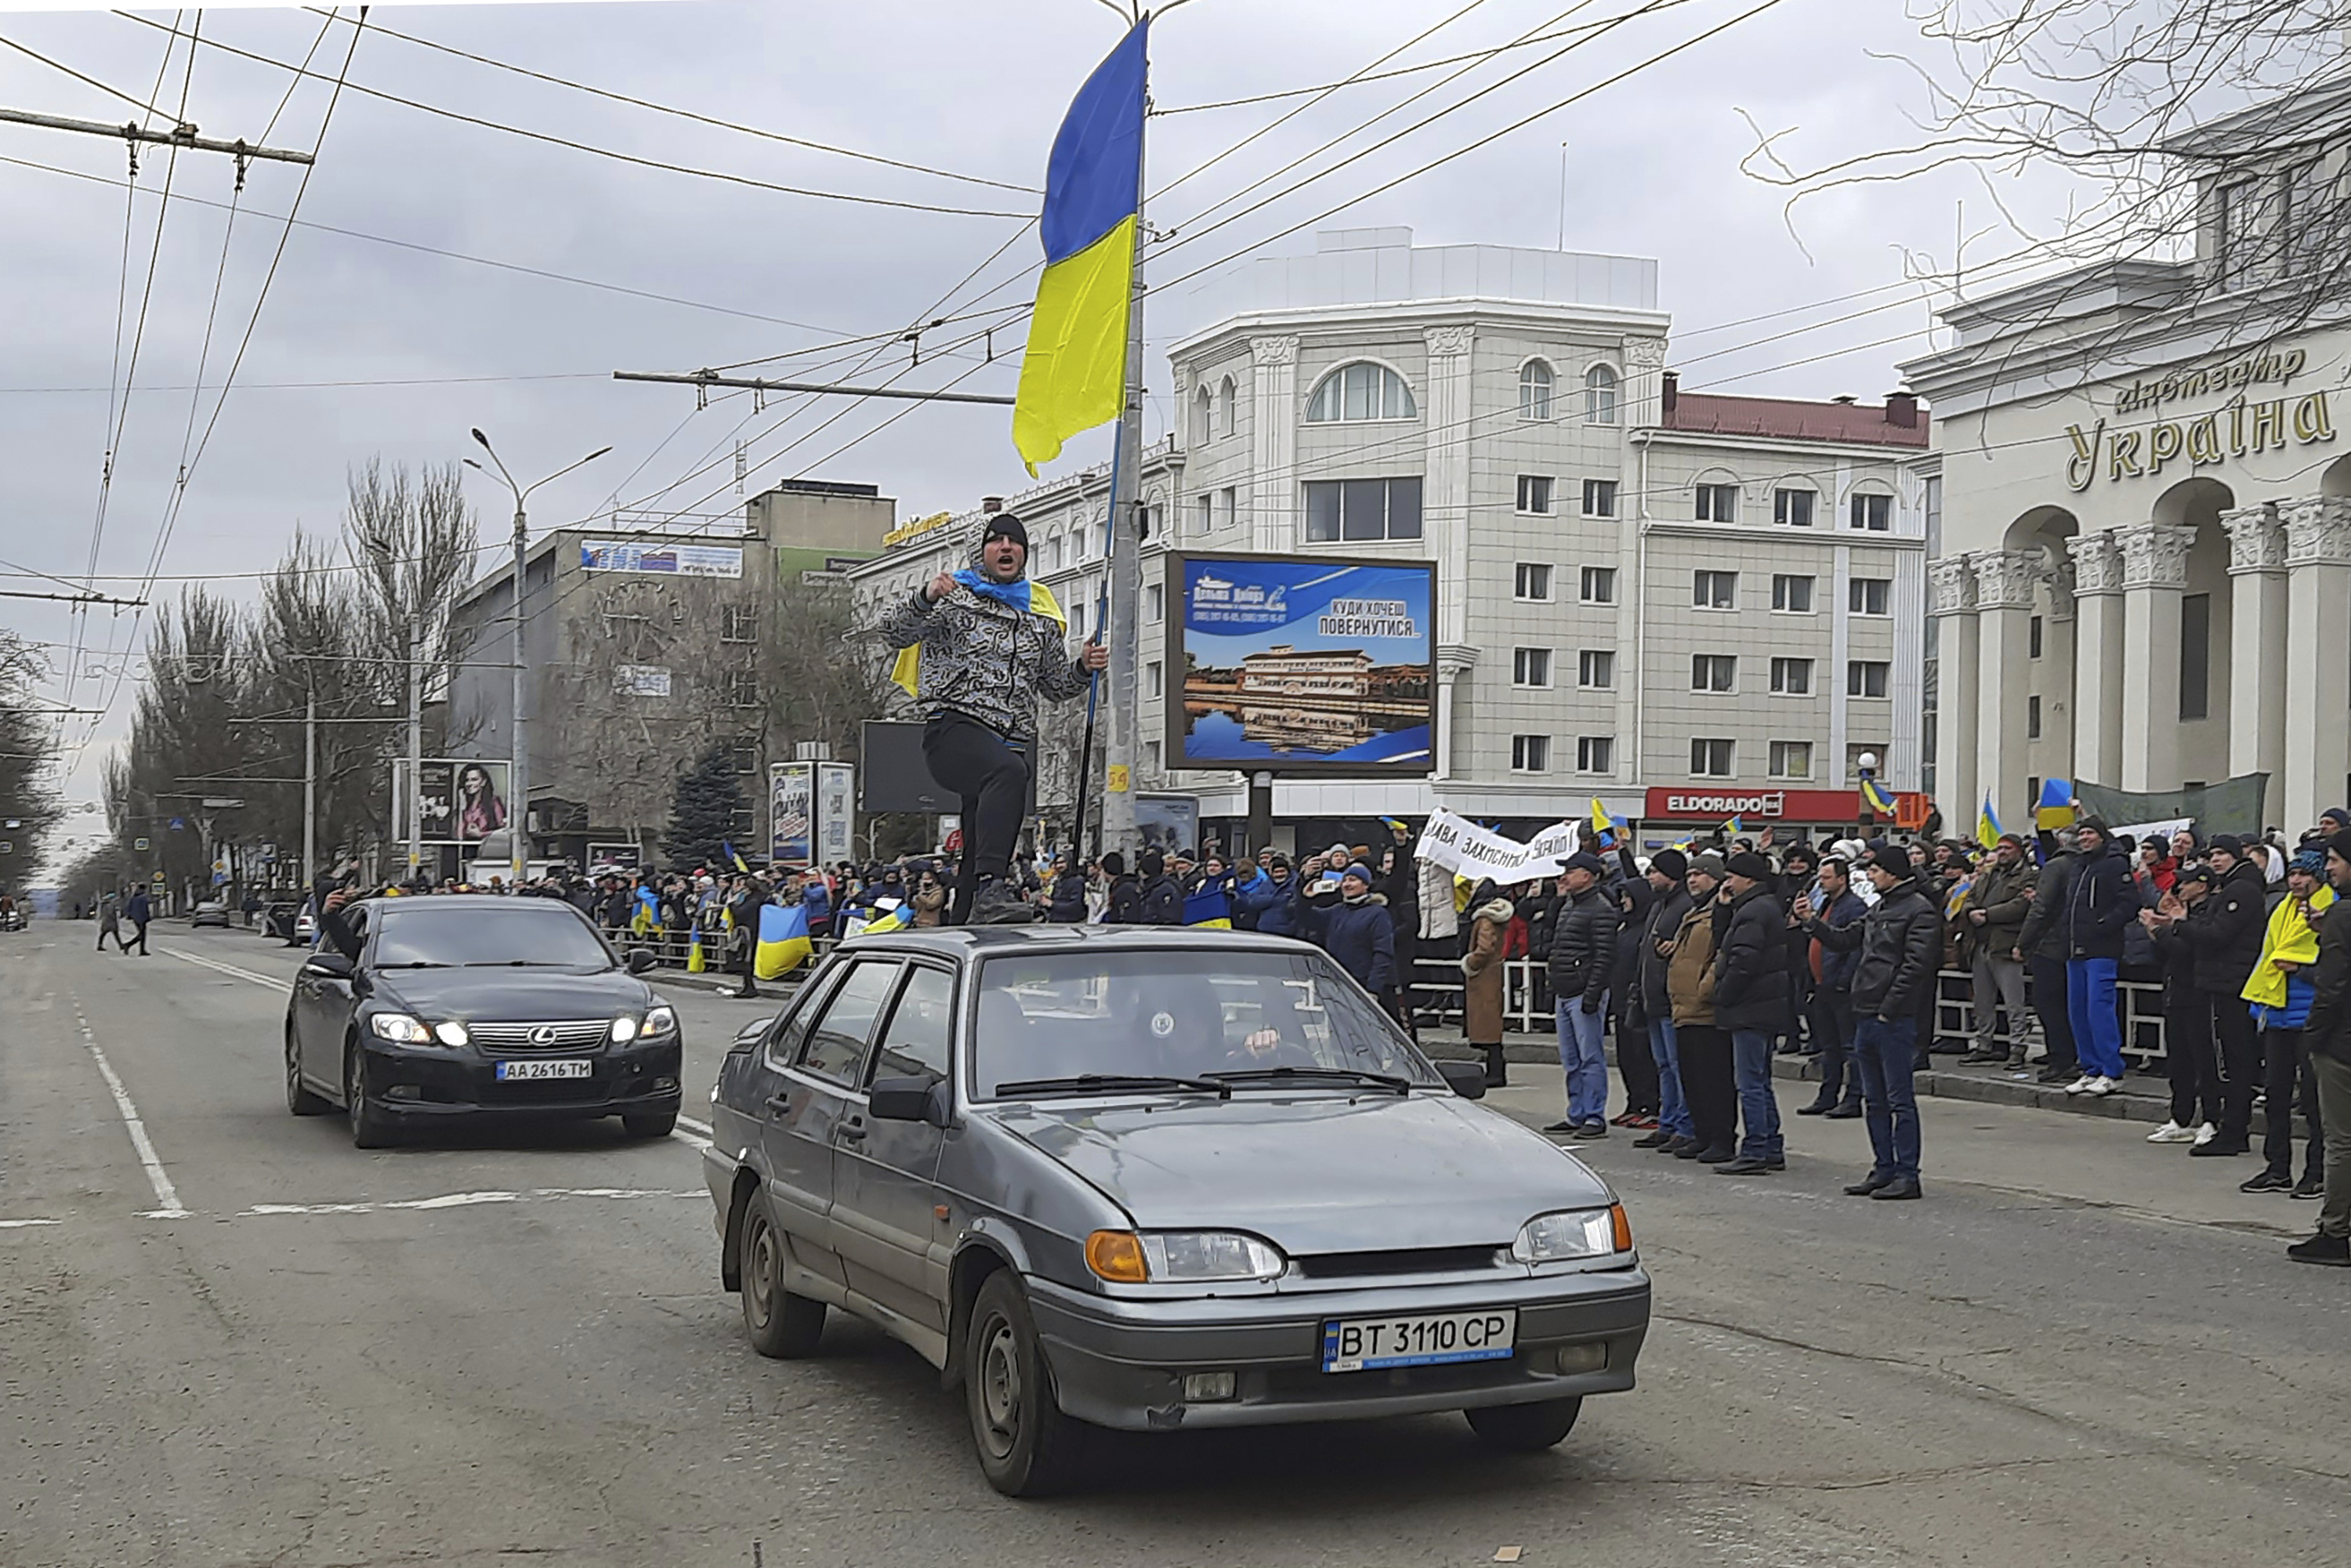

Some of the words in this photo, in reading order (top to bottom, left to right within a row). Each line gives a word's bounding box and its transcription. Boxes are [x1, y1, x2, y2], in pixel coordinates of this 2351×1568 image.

[2063, 390, 2338, 494] Україна
[1332, 600, 1362, 615] КУДИ
[1366, 602, 1405, 616] ХОЧЕШ
[1667, 795, 1762, 812] ELDORADO
[507, 1064, 527, 1077] AA
[531, 1063, 566, 1077] 2616
[568, 1063, 590, 1076] TM
[1341, 1324, 1386, 1356] BT
[1393, 1320, 1456, 1352] 3110
[1464, 1316, 1505, 1346] CP
